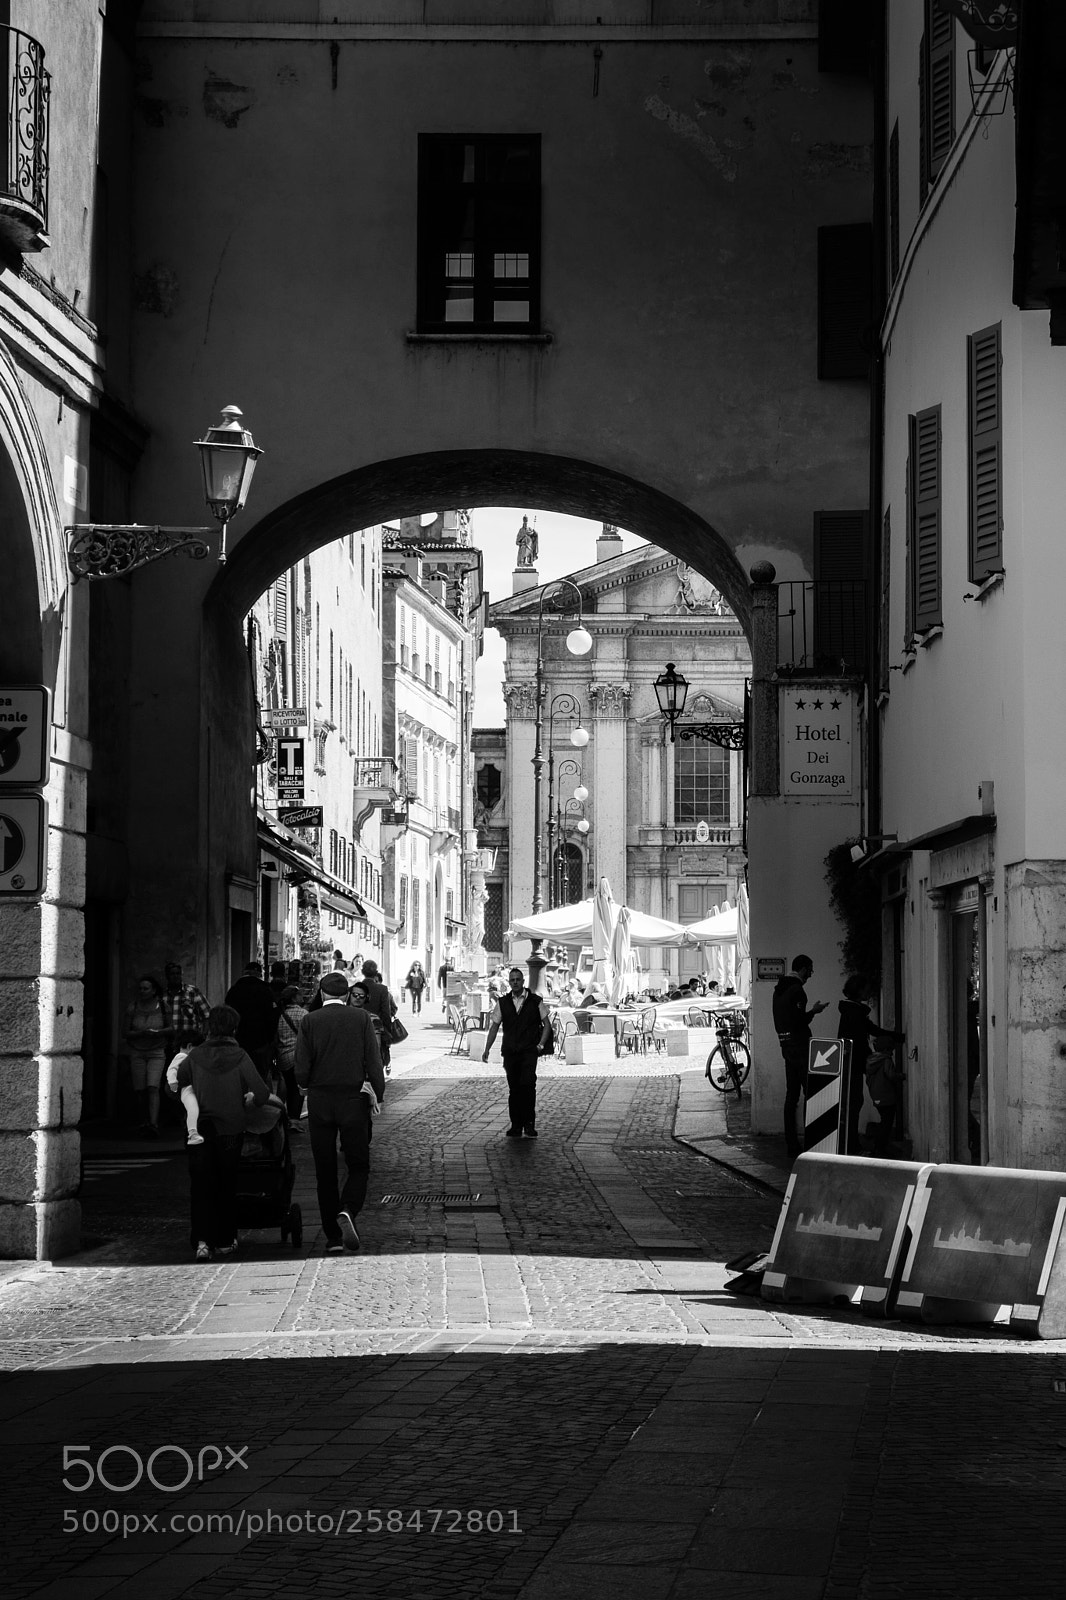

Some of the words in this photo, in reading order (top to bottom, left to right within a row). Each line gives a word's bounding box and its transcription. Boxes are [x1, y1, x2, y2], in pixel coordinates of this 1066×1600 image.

[795, 724, 841, 741] Hotel
[281, 742, 300, 775] T
[806, 751, 830, 764] Dei
[790, 770, 846, 788] Gonzaga
[281, 808, 321, 825] Totocalcio
